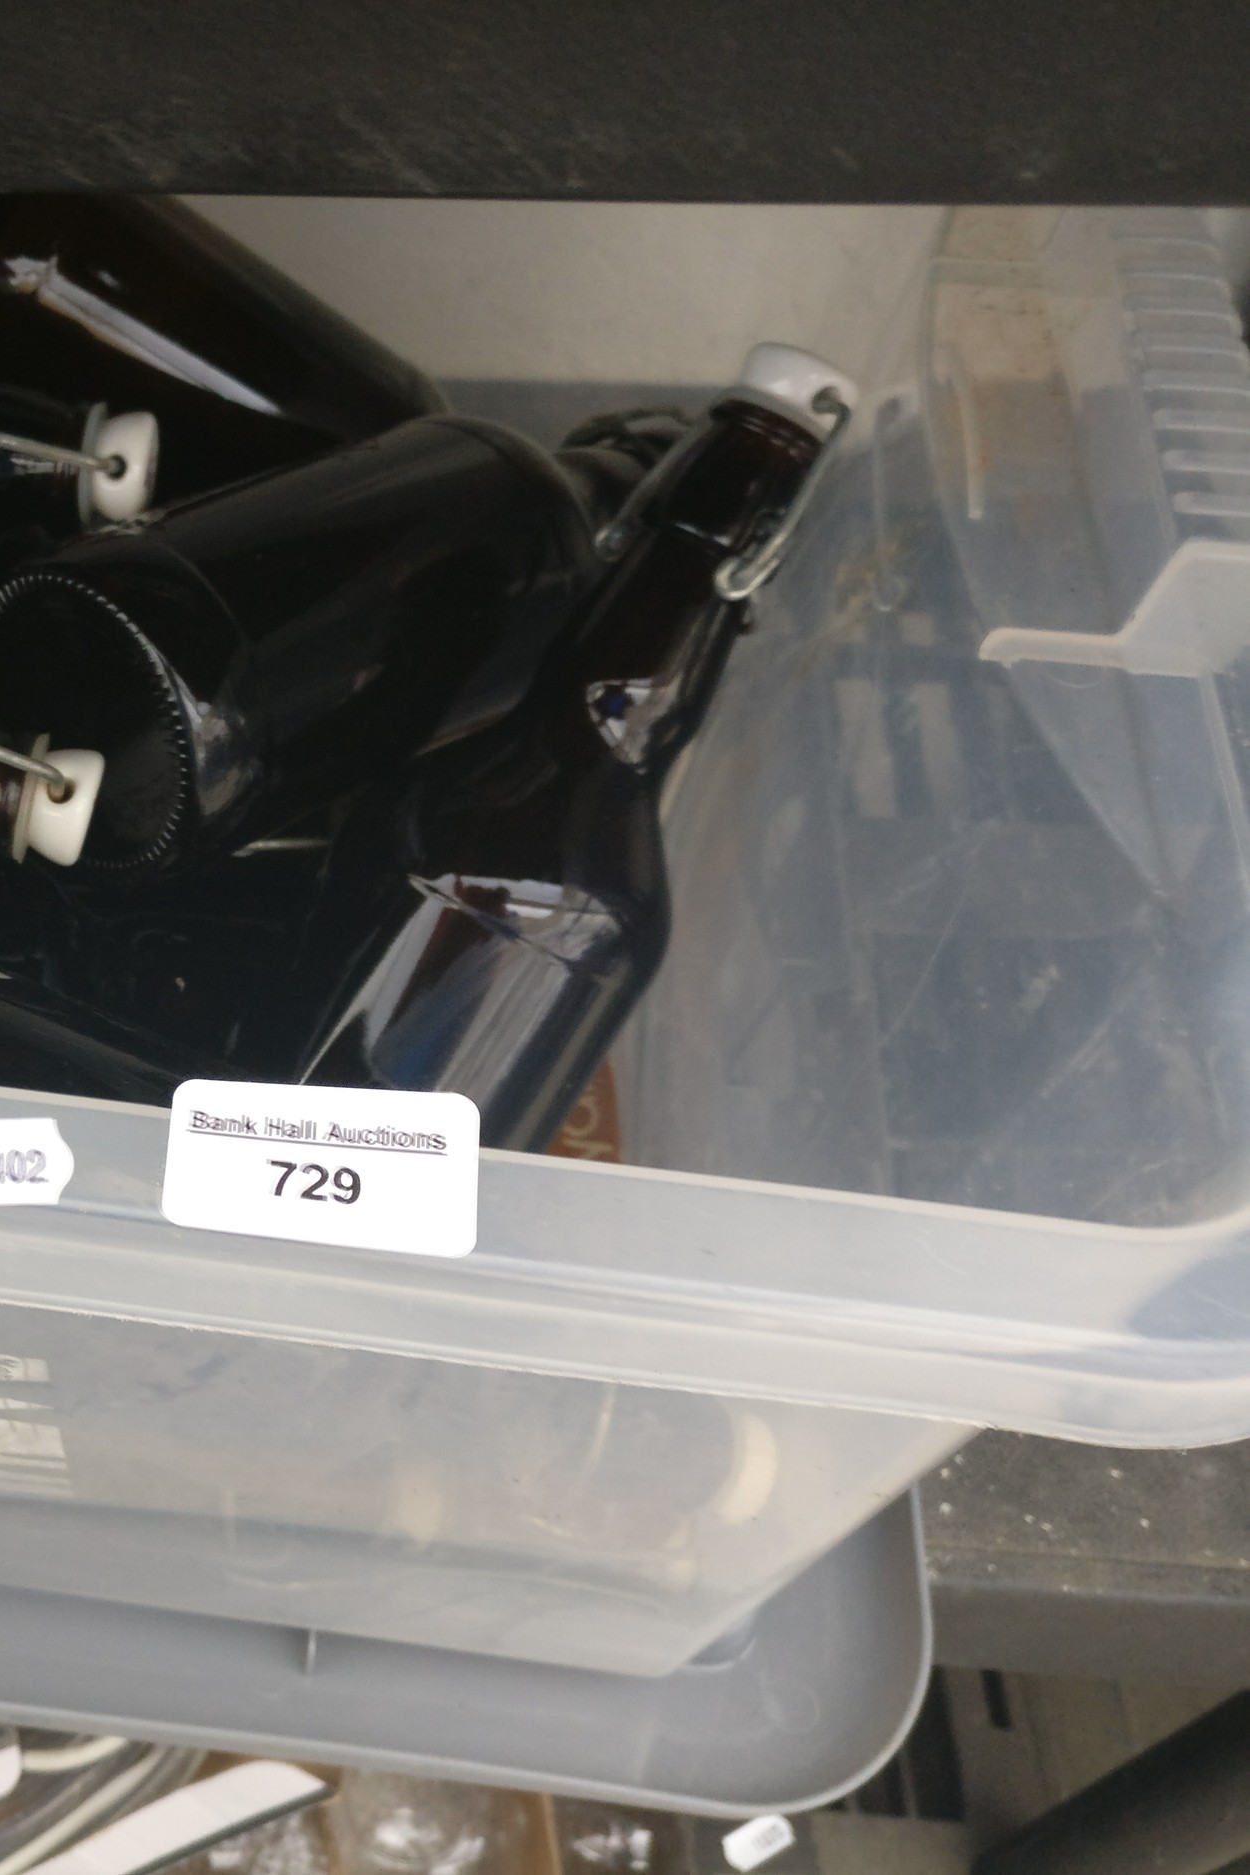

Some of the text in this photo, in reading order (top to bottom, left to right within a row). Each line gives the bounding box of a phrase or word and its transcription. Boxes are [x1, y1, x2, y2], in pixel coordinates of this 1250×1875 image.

[190, 1109, 448, 1151] Bank Hall Auctions
[266, 1158, 362, 1205] 729
